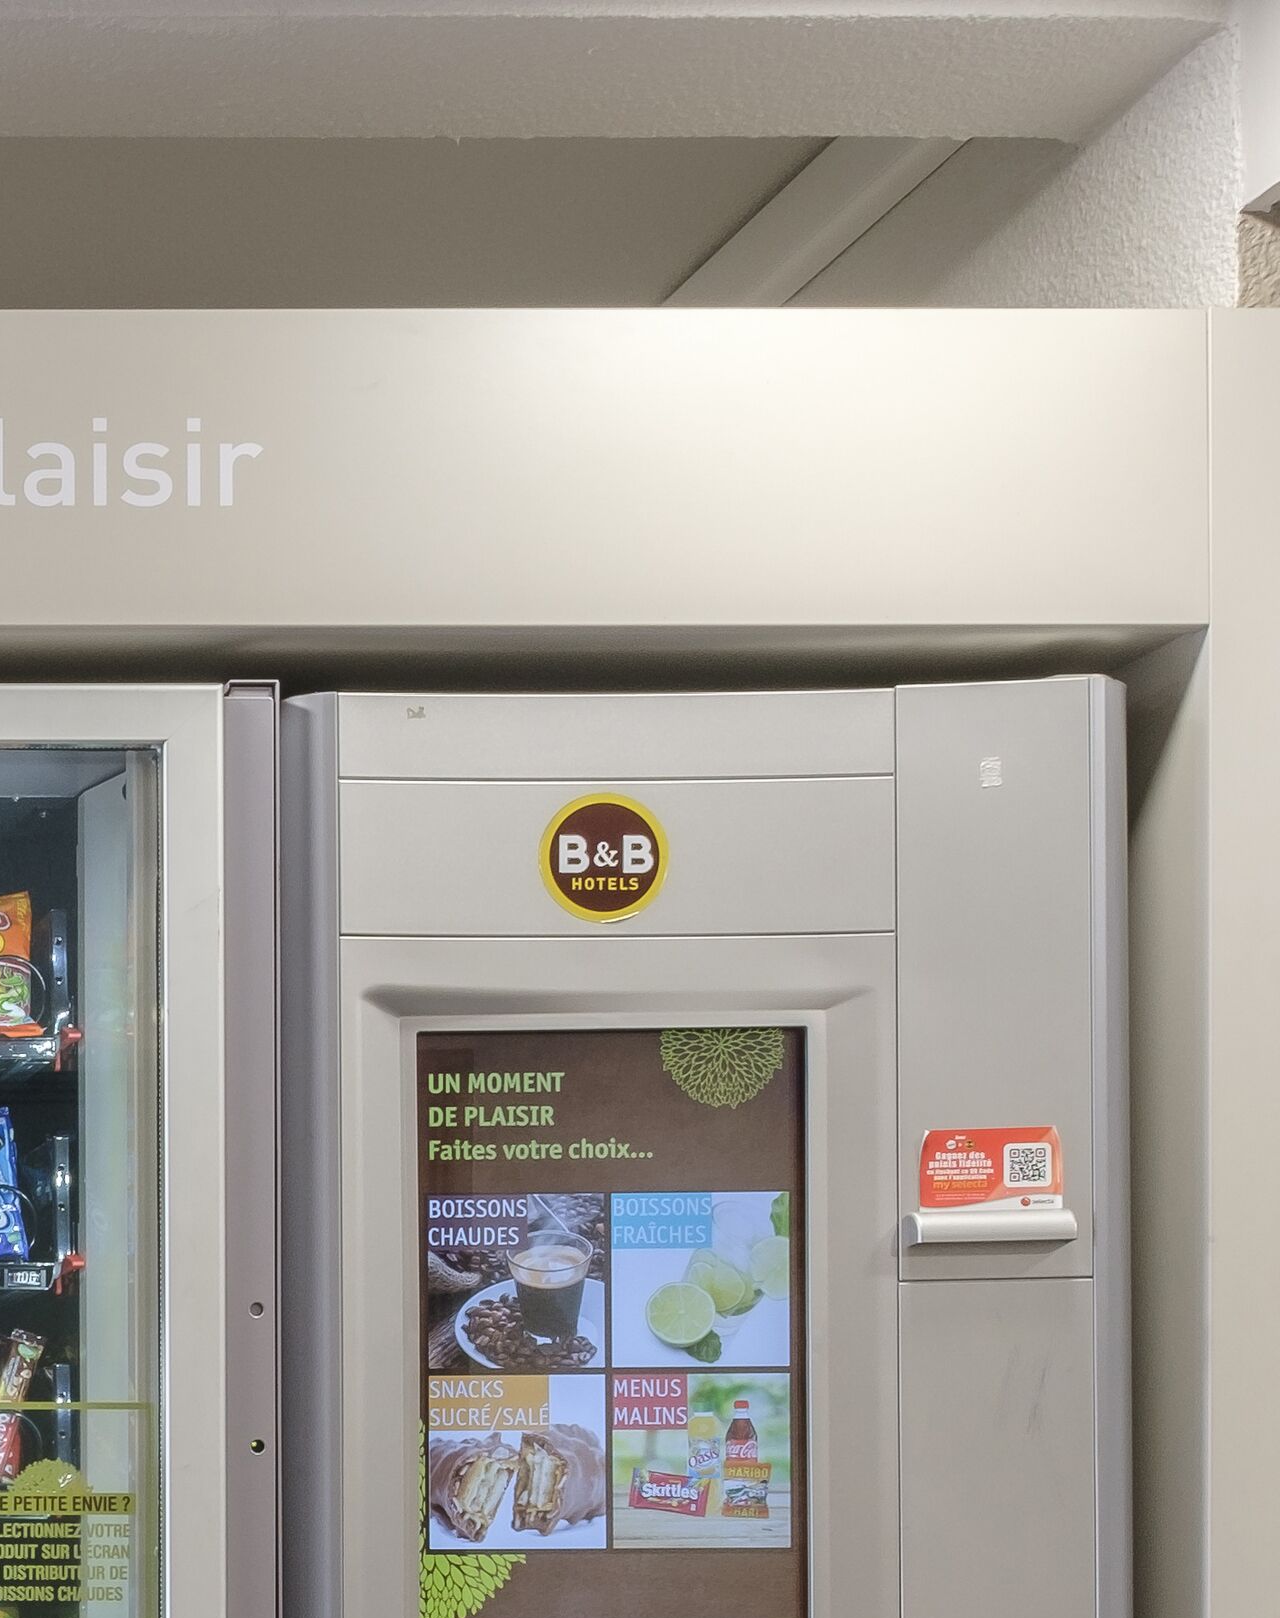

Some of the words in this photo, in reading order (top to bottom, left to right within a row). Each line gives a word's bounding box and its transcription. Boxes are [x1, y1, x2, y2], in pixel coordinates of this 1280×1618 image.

[558, 834, 655, 874] B&B
[571, 877, 640, 891] HOTELS
[427, 1073, 461, 1094] UN
[468, 1071, 565, 1094] MOMENT
[428, 1106, 458, 1127] DE
[464, 1105, 555, 1127] PLAISIR
[428, 1139, 497, 1161] Faites
[503, 1140, 563, 1160] votre
[568, 1137, 654, 1160] choix...
[428, 1198, 527, 1219] BOISSONS
[612, 1196, 712, 1217] BOISSONS
[428, 1226, 520, 1247] CHAUDES
[612, 1221, 707, 1245] FRAÎCHES
[428, 1379, 505, 1399] SNACKS
[613, 1379, 682, 1398] MENUS
[428, 1403, 550, 1431] SUCRÉ/SALÉ
[613, 1405, 688, 1426] MALINS
[688, 1450, 720, 1468] Oasis
[727, 1467, 769, 1479] HARIBO
[641, 1482, 699, 1500] Skittles
[13, 1496, 68, 1511] PETITE
[72, 1496, 118, 1511] ENVIE
[123, 1496, 131, 1511] ?
[89, 1522, 130, 1537] VOTRE
[41, 1544, 70, 1560] SUR
[109, 1564, 128, 1580] DE
[57, 1585, 123, 1602] CHAUDES
